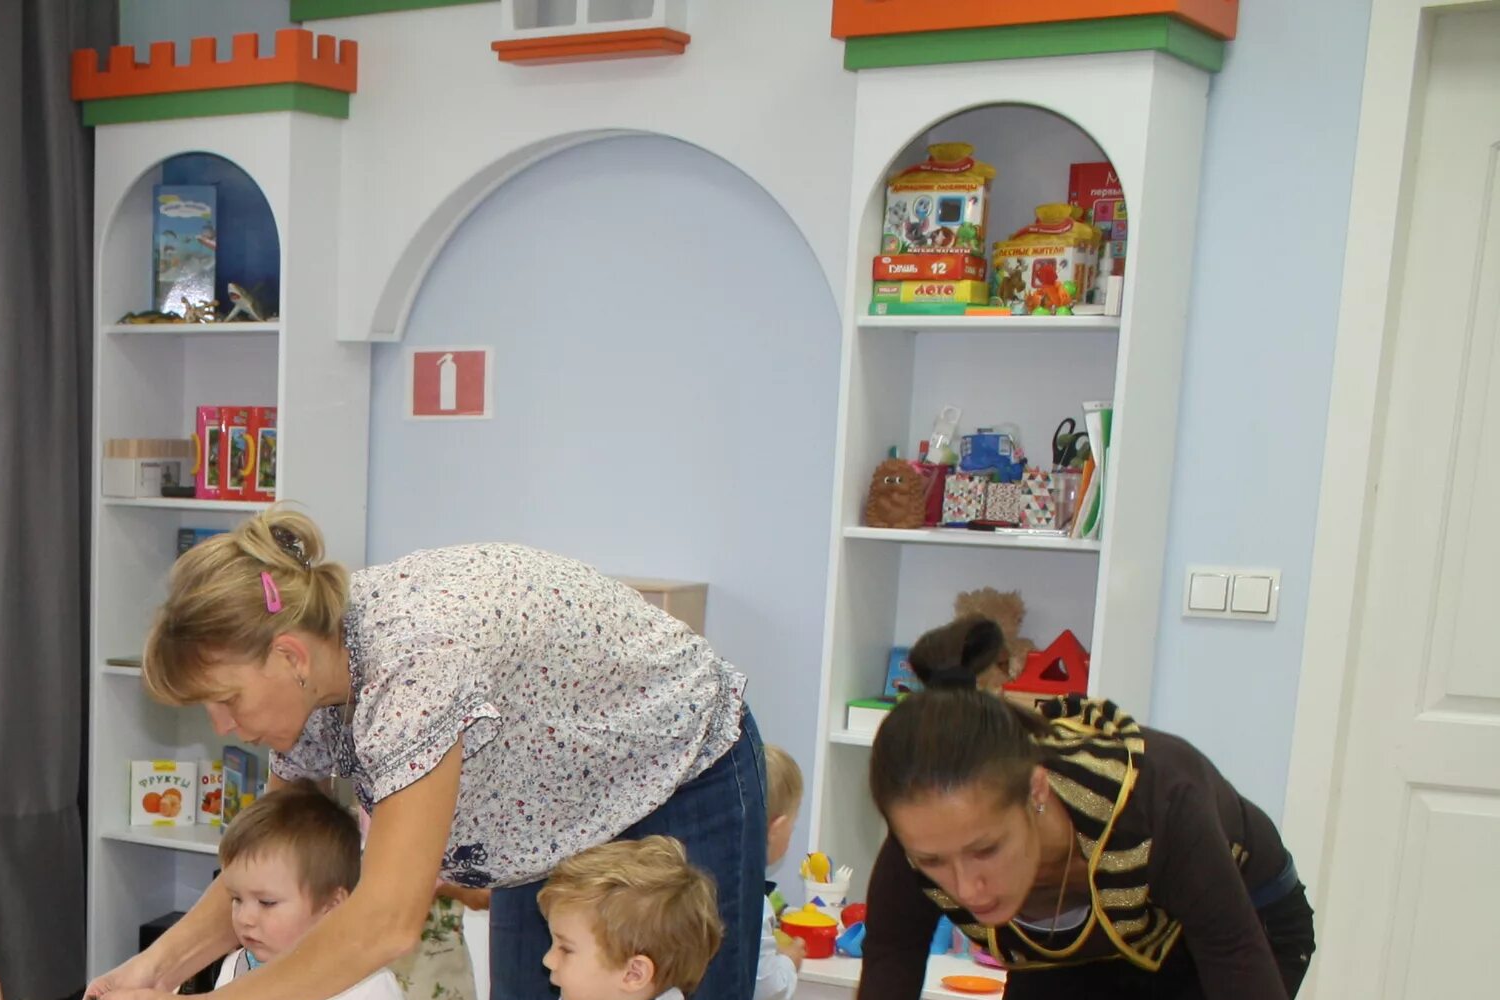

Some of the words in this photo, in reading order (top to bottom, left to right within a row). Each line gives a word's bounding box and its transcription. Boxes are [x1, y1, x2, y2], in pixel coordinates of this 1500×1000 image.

[930, 262, 947, 275] 12
[914, 284, 956, 296] ЛОТО
[140, 775, 191, 788] ФРУКТЫ
